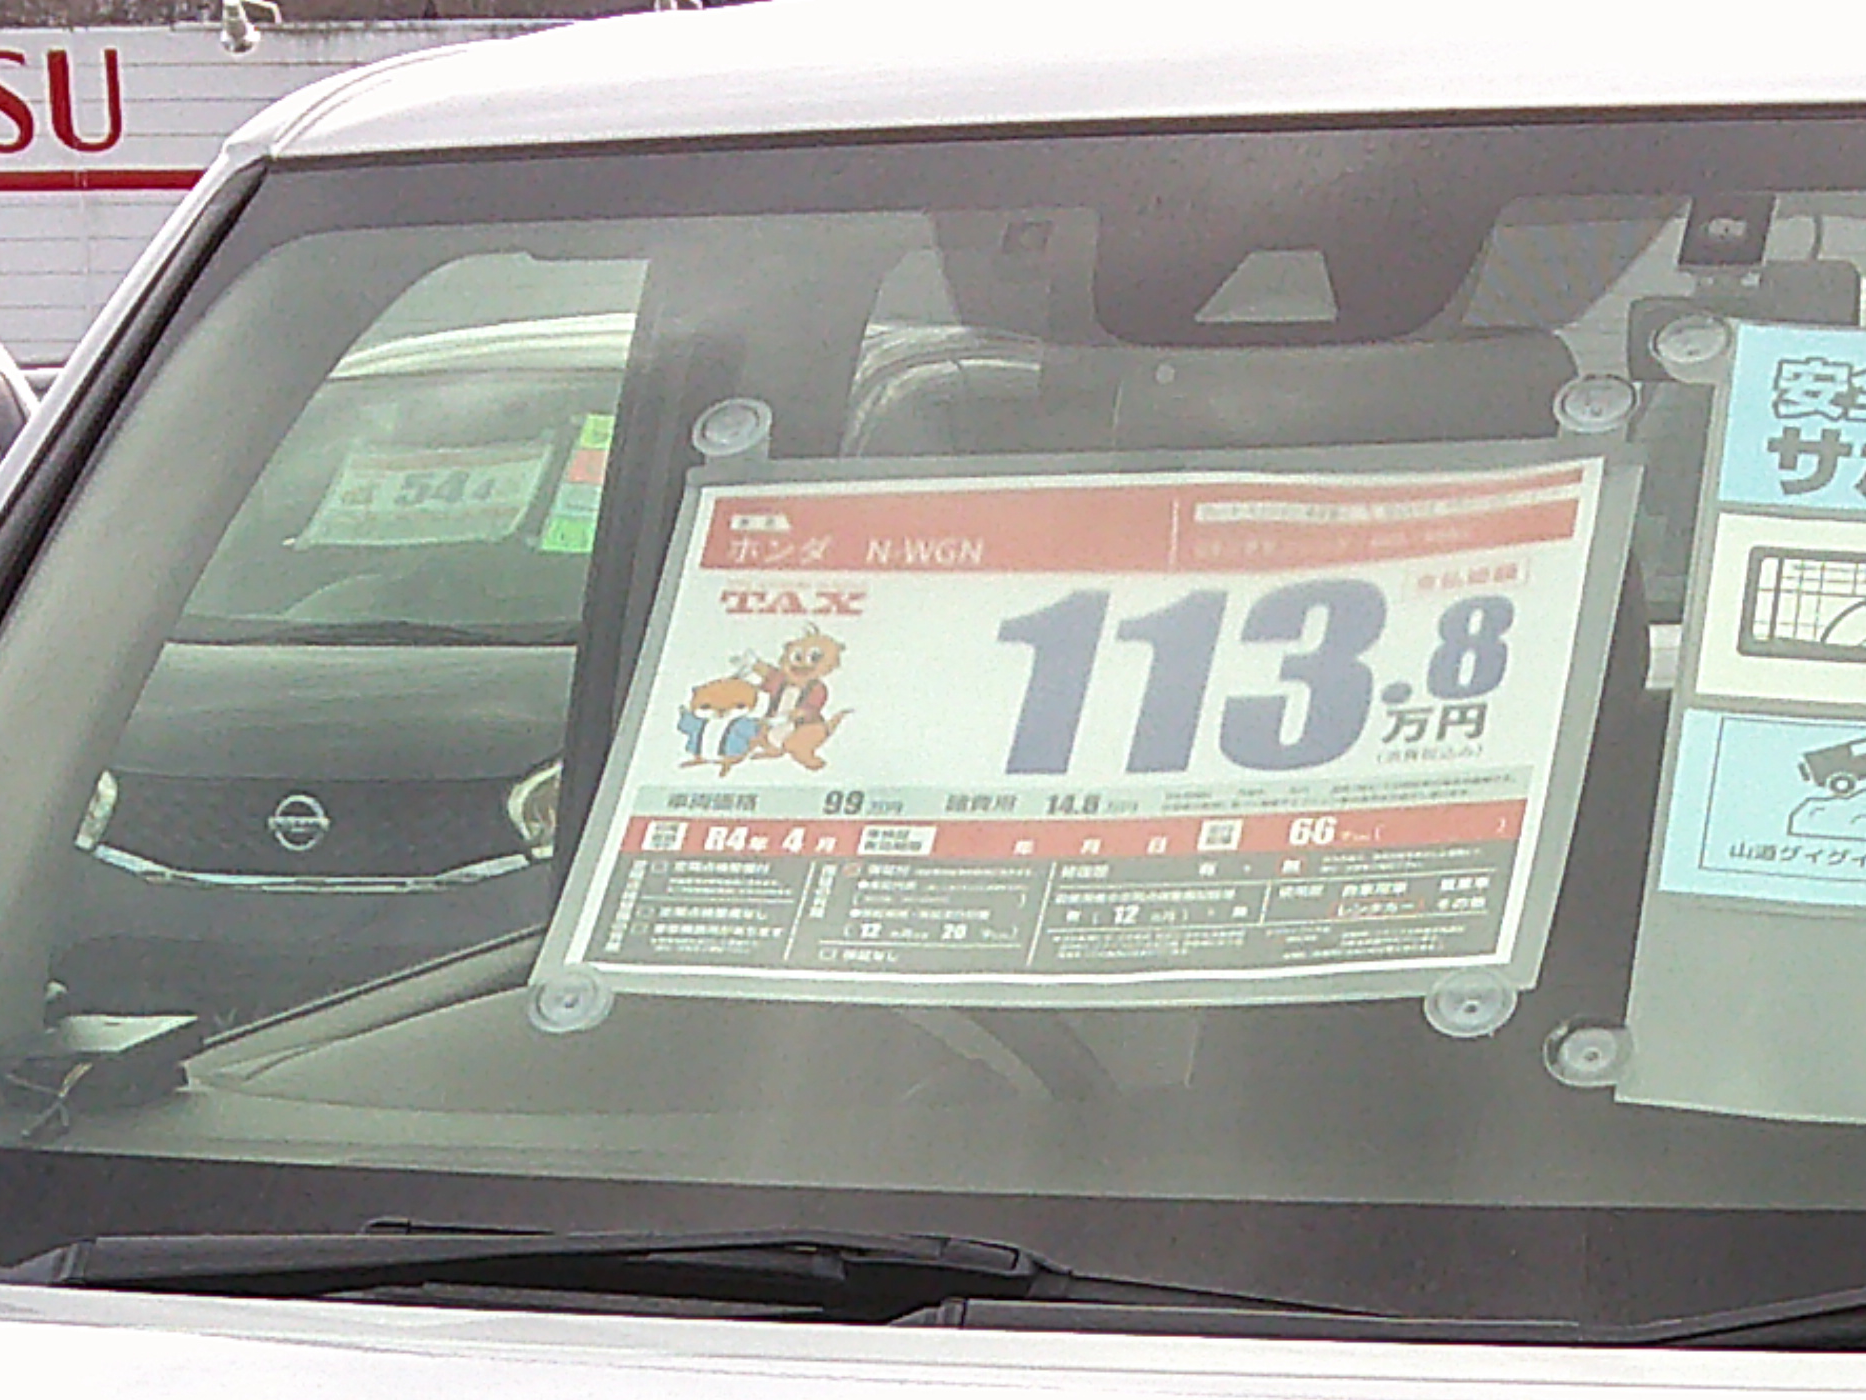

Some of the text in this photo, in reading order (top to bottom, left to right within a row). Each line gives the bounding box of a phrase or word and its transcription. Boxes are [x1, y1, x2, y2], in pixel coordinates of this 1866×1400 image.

[730, 536, 985, 565] ホンダ N-WGN
[720, 590, 867, 616] TAX
[997, 578, 1515, 771] 113.8 万円
[823, 790, 865, 815] 99
[1289, 816, 1336, 845] 66
